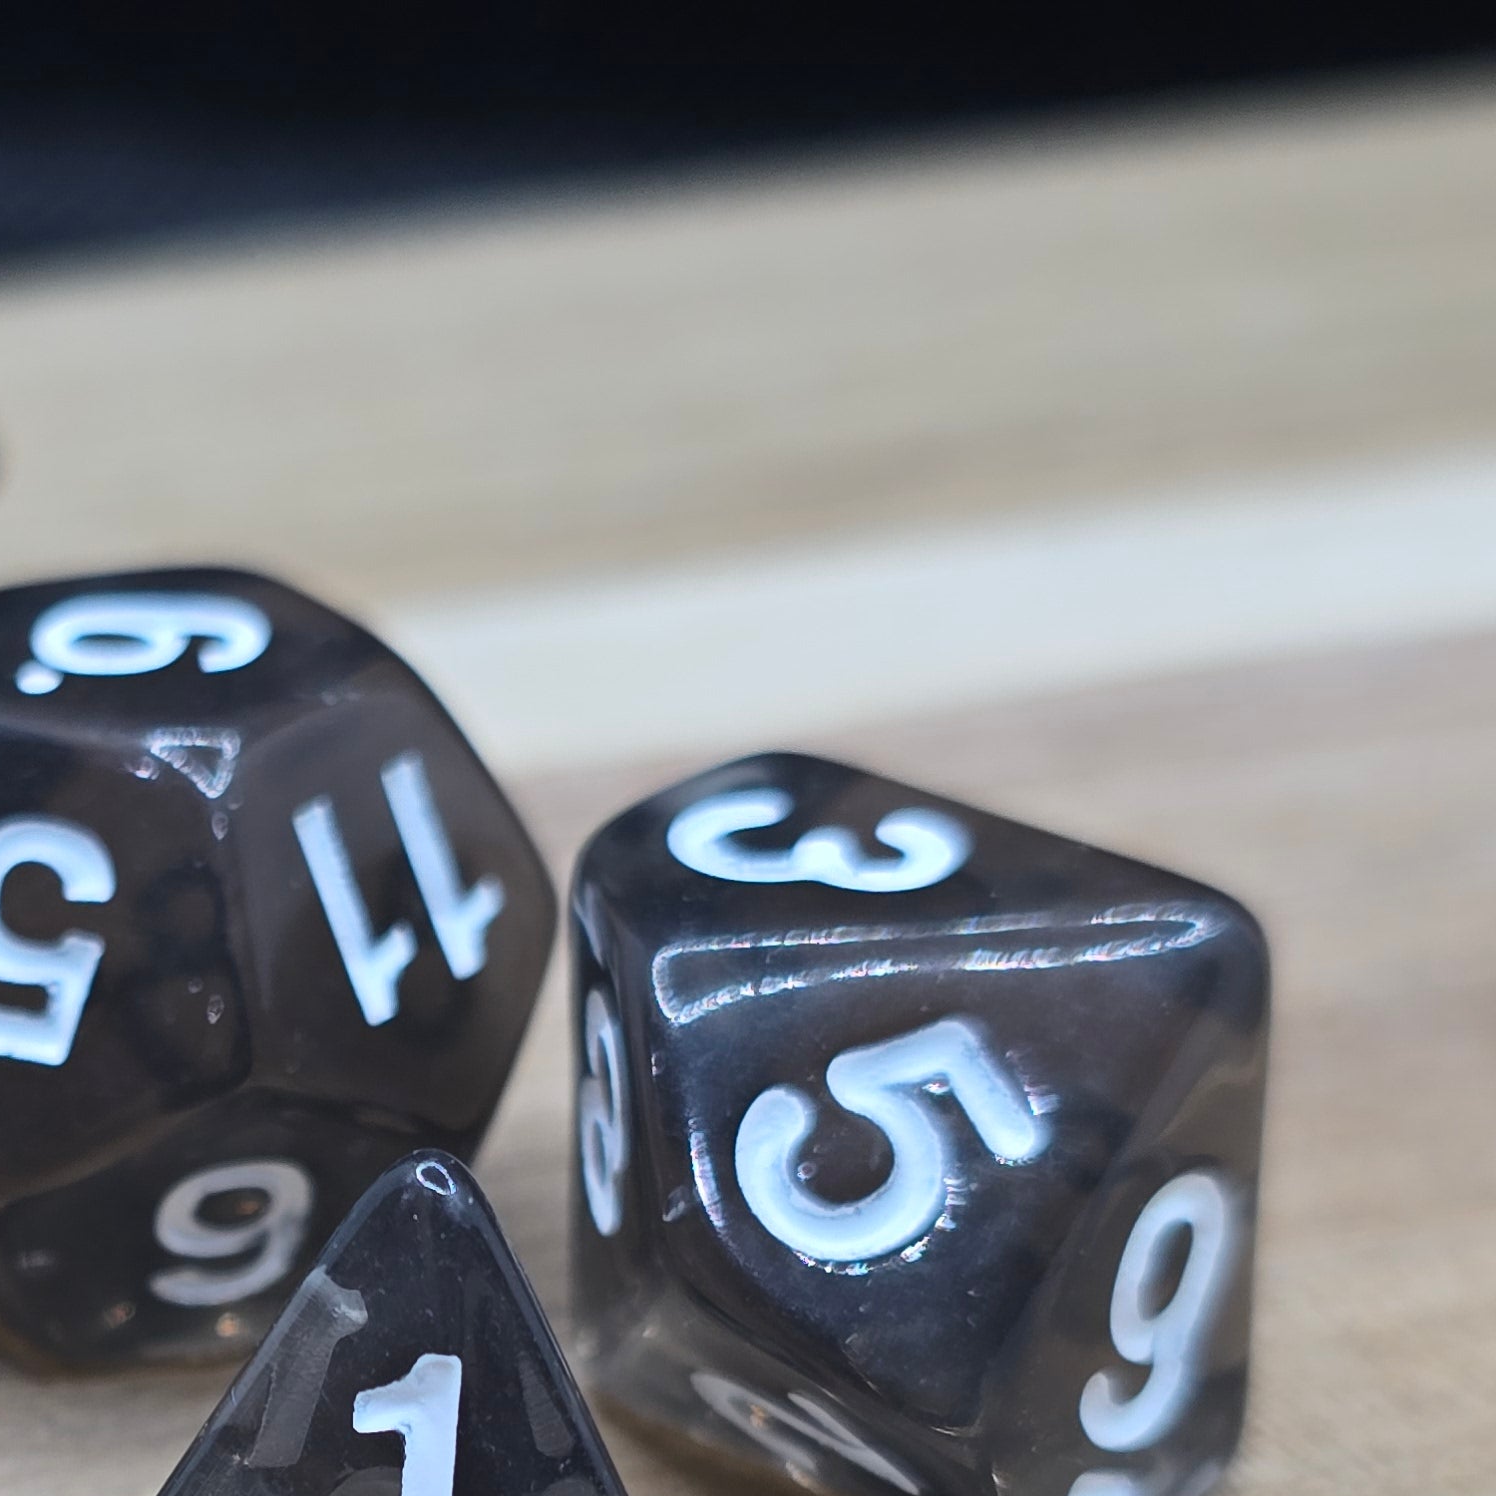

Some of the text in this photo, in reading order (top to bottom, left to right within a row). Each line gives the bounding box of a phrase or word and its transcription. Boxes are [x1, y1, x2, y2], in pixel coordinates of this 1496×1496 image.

[292, 751, 505, 1027] 11
[666, 789, 971, 893] 3
[734, 1018, 1048, 1264] 5
